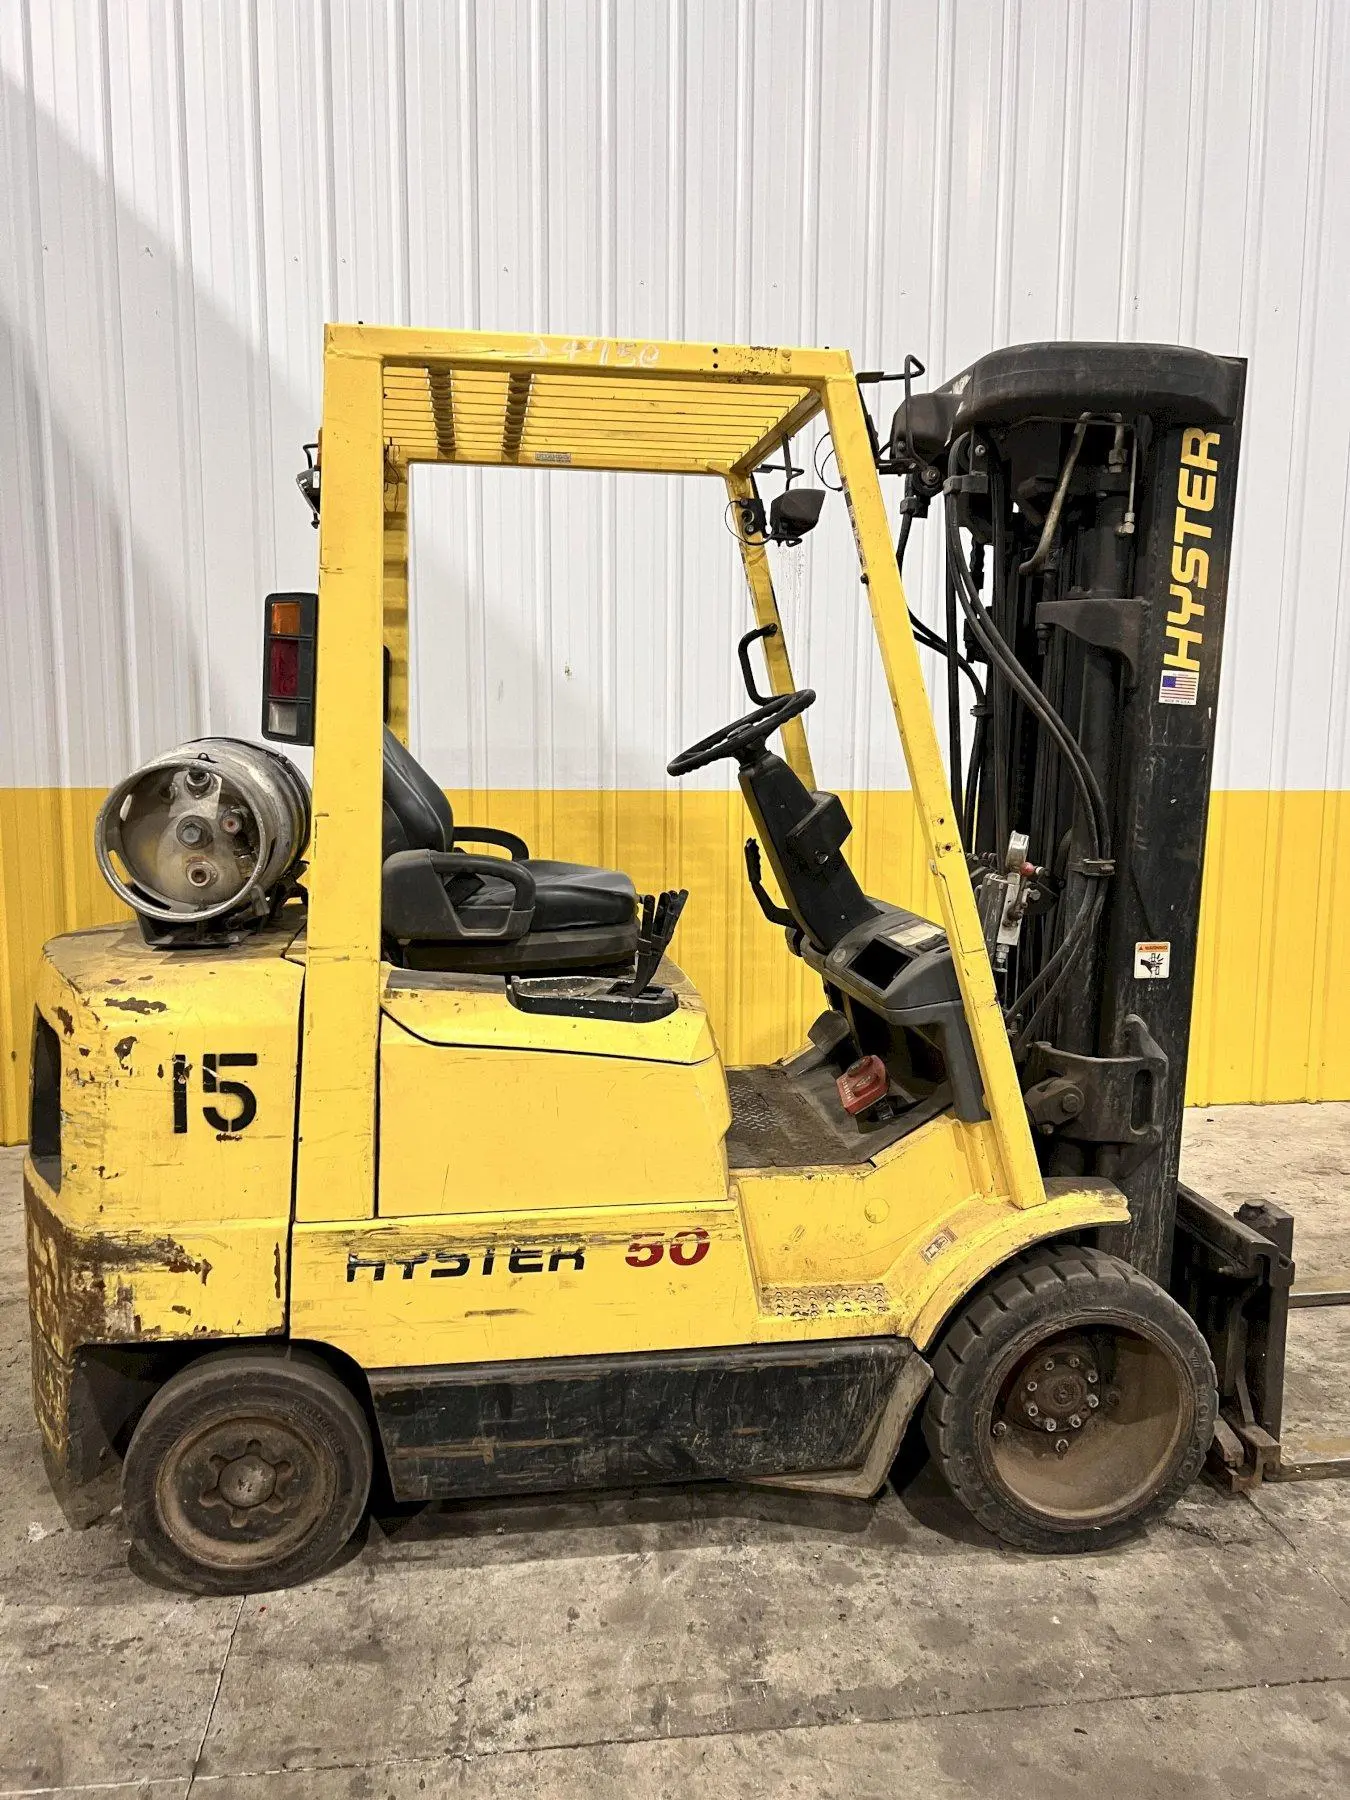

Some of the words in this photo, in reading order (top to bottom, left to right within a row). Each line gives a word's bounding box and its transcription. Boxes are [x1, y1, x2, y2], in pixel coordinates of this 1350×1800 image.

[1163, 427, 1221, 672] HYSTER
[172, 1053, 258, 1134] 15
[624, 1227, 711, 1268] 50
